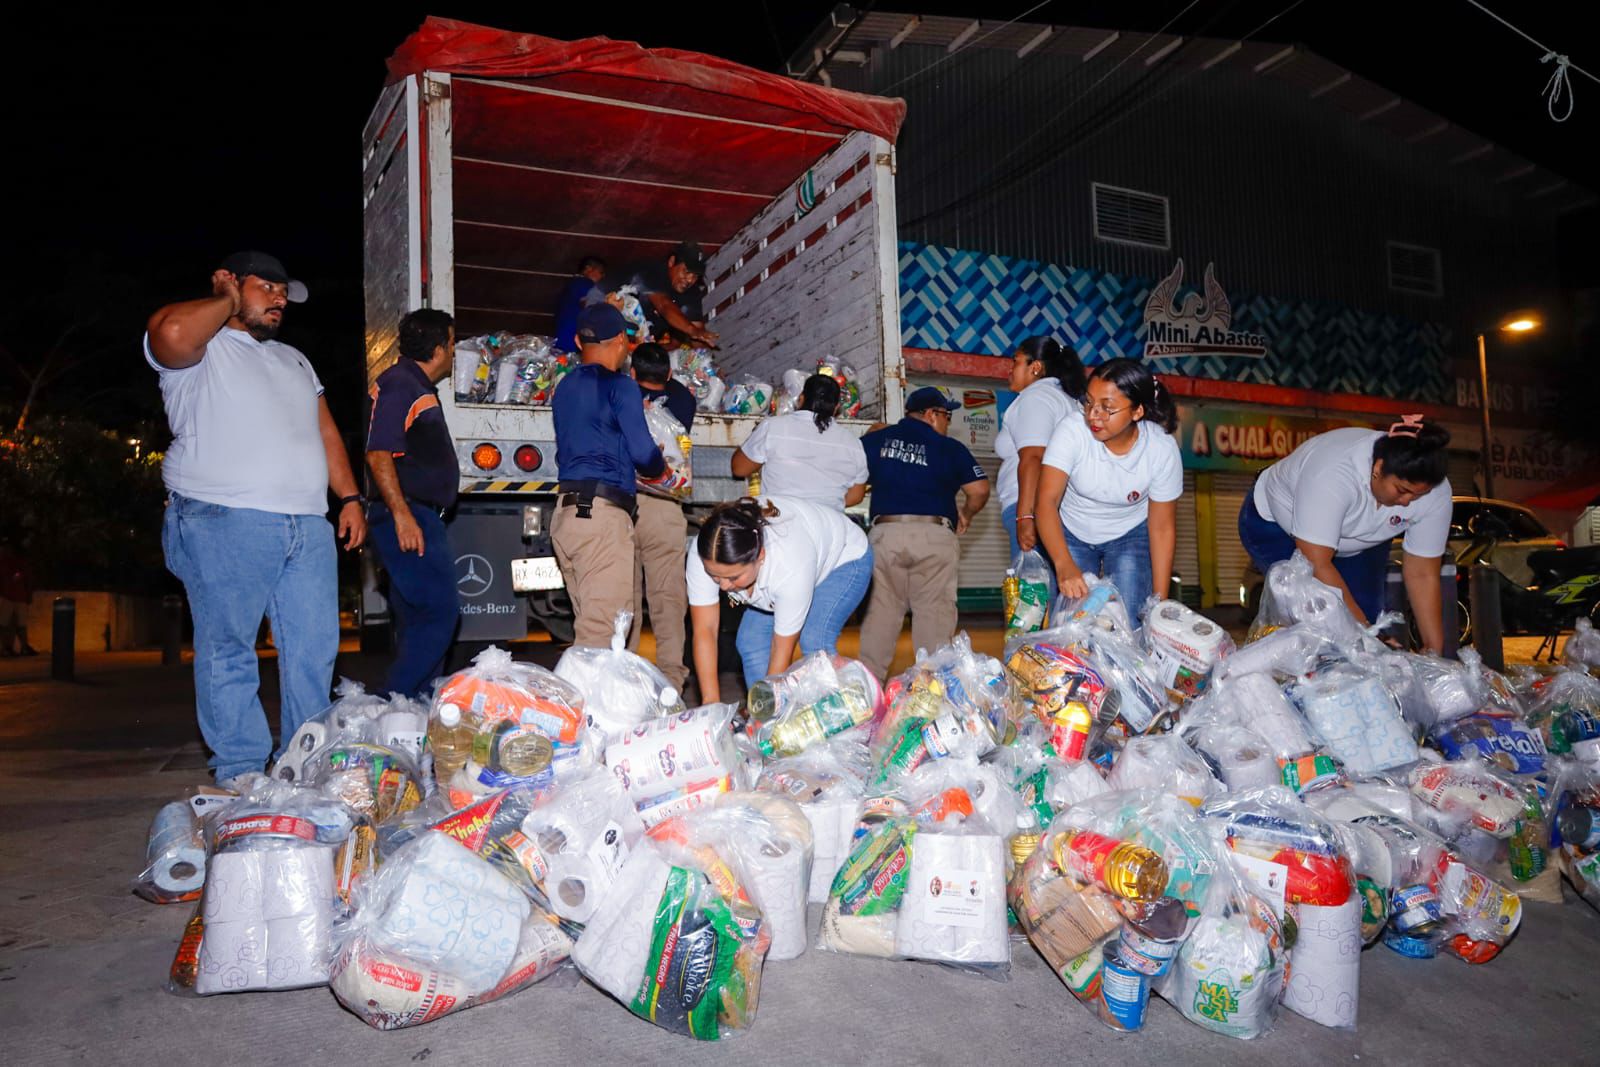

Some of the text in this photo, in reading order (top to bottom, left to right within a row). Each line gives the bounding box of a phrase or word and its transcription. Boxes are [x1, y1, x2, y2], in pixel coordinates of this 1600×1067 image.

[1149, 321, 1189, 343] Mini
[1455, 377, 1514, 413] BAOS
[1192, 421, 1210, 456] A
[460, 602, 516, 615] edes-Benz
[657, 953, 671, 983] NEGRO
